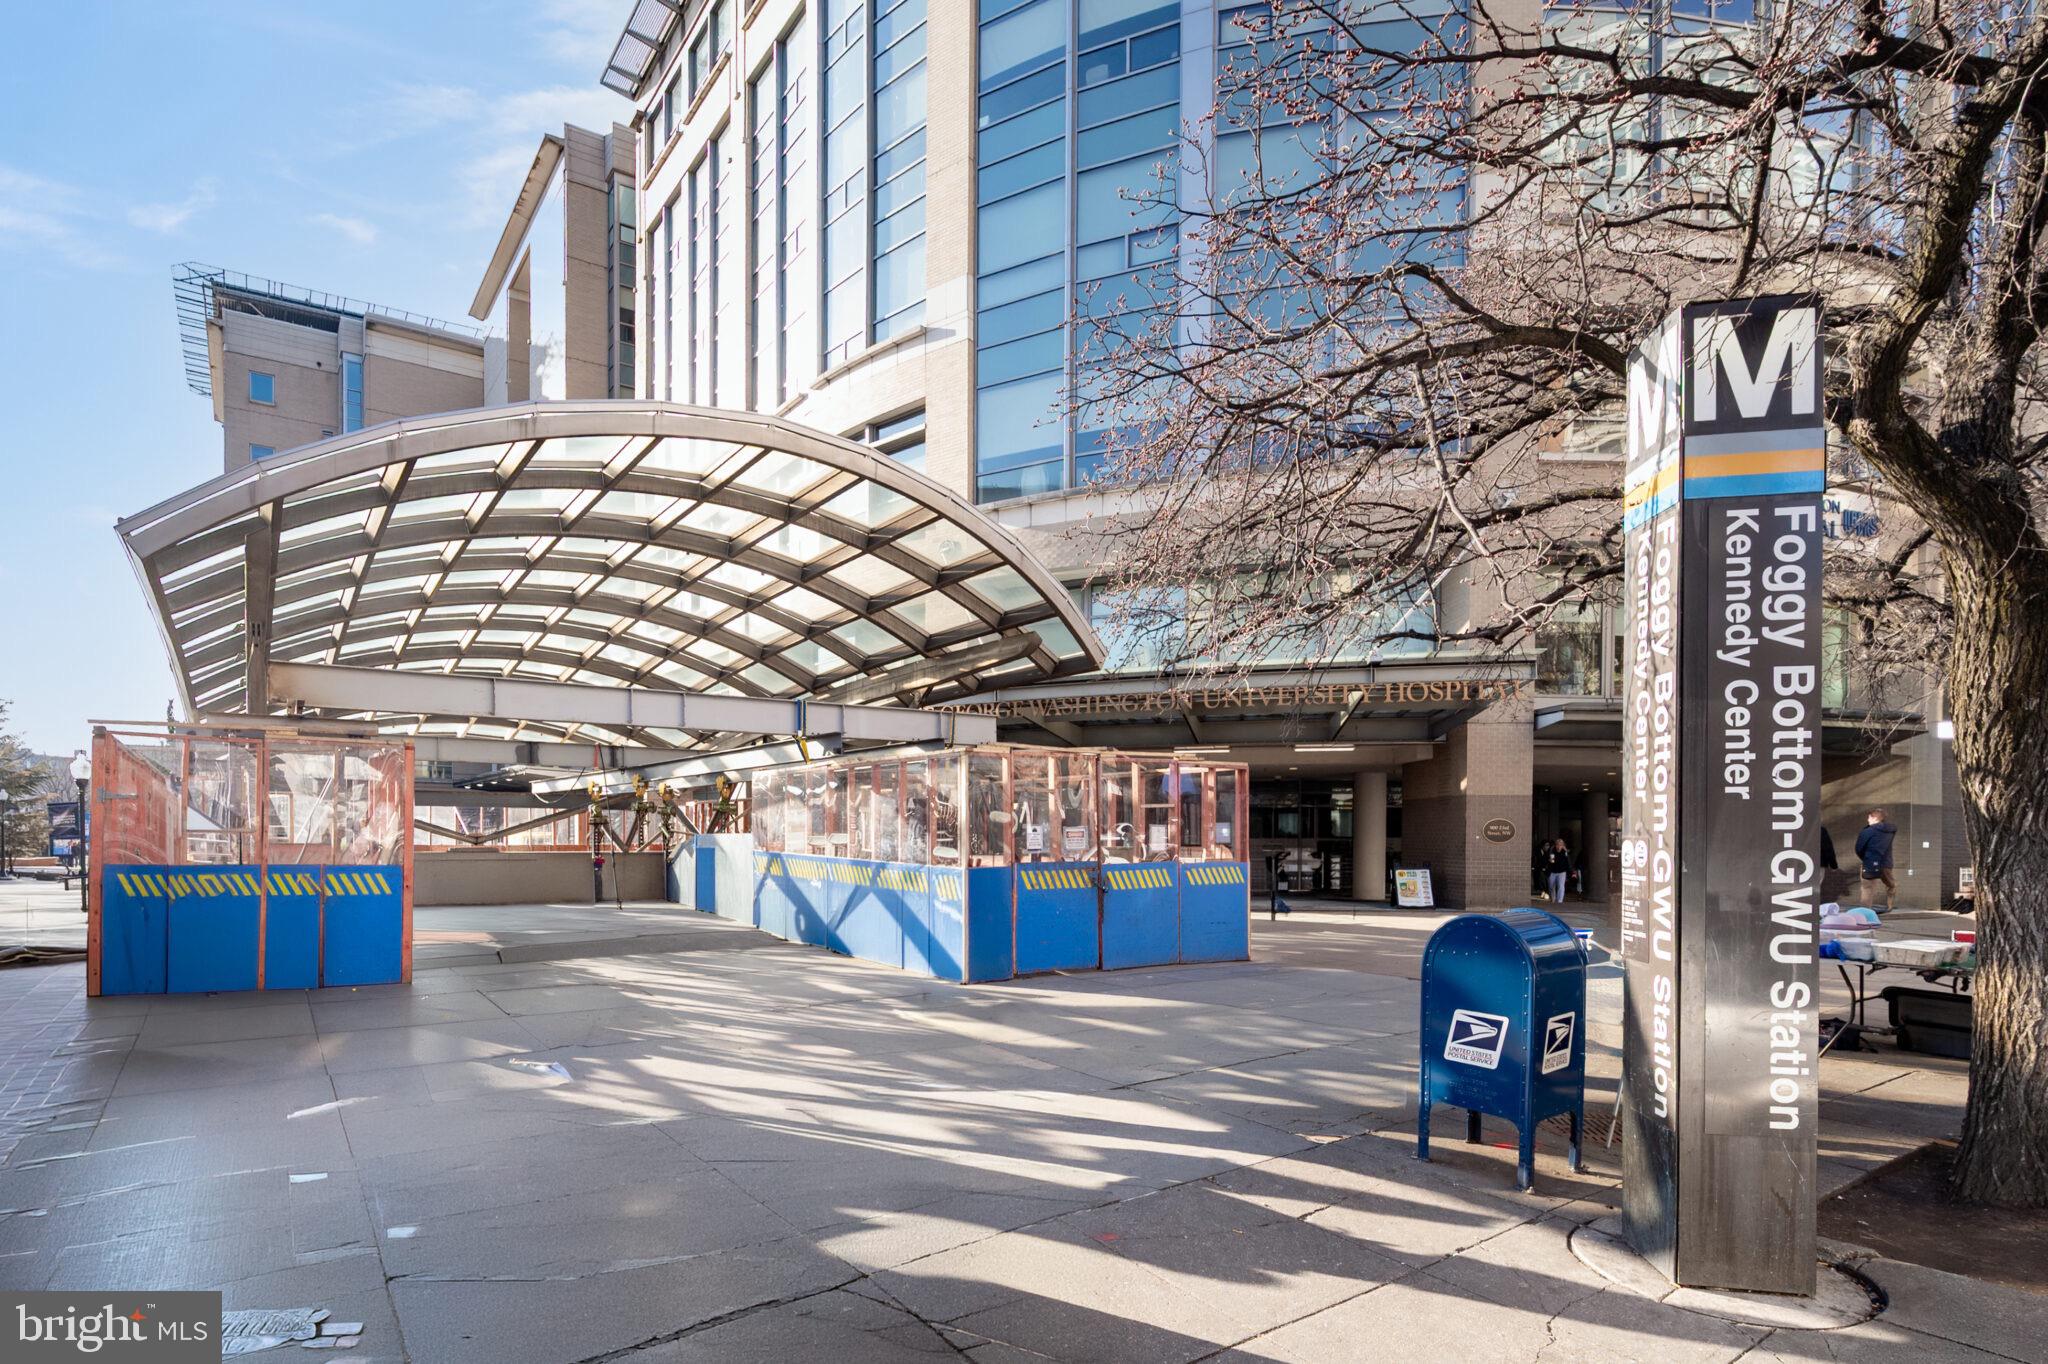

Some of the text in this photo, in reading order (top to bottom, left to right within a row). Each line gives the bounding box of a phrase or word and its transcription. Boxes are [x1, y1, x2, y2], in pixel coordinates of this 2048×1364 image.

[1629, 323, 1679, 463] M
[1693, 307, 1816, 422] M
[1031, 690, 1193, 717] WASHINGTON
[1203, 683, 1375, 709] UNIVERSITY
[1633, 529, 1652, 803] Kennedy Center
[1716, 508, 1760, 800] Kennedy Center
[1651, 517, 1676, 1119] Foggy Bottom-GWU Station
[1762, 505, 1817, 1130] Foggy Bottom-GWU Station
[1447, 1051, 1494, 1066] POSTAL SERVICE
[1448, 1045, 1493, 1059] UNITED STATES
